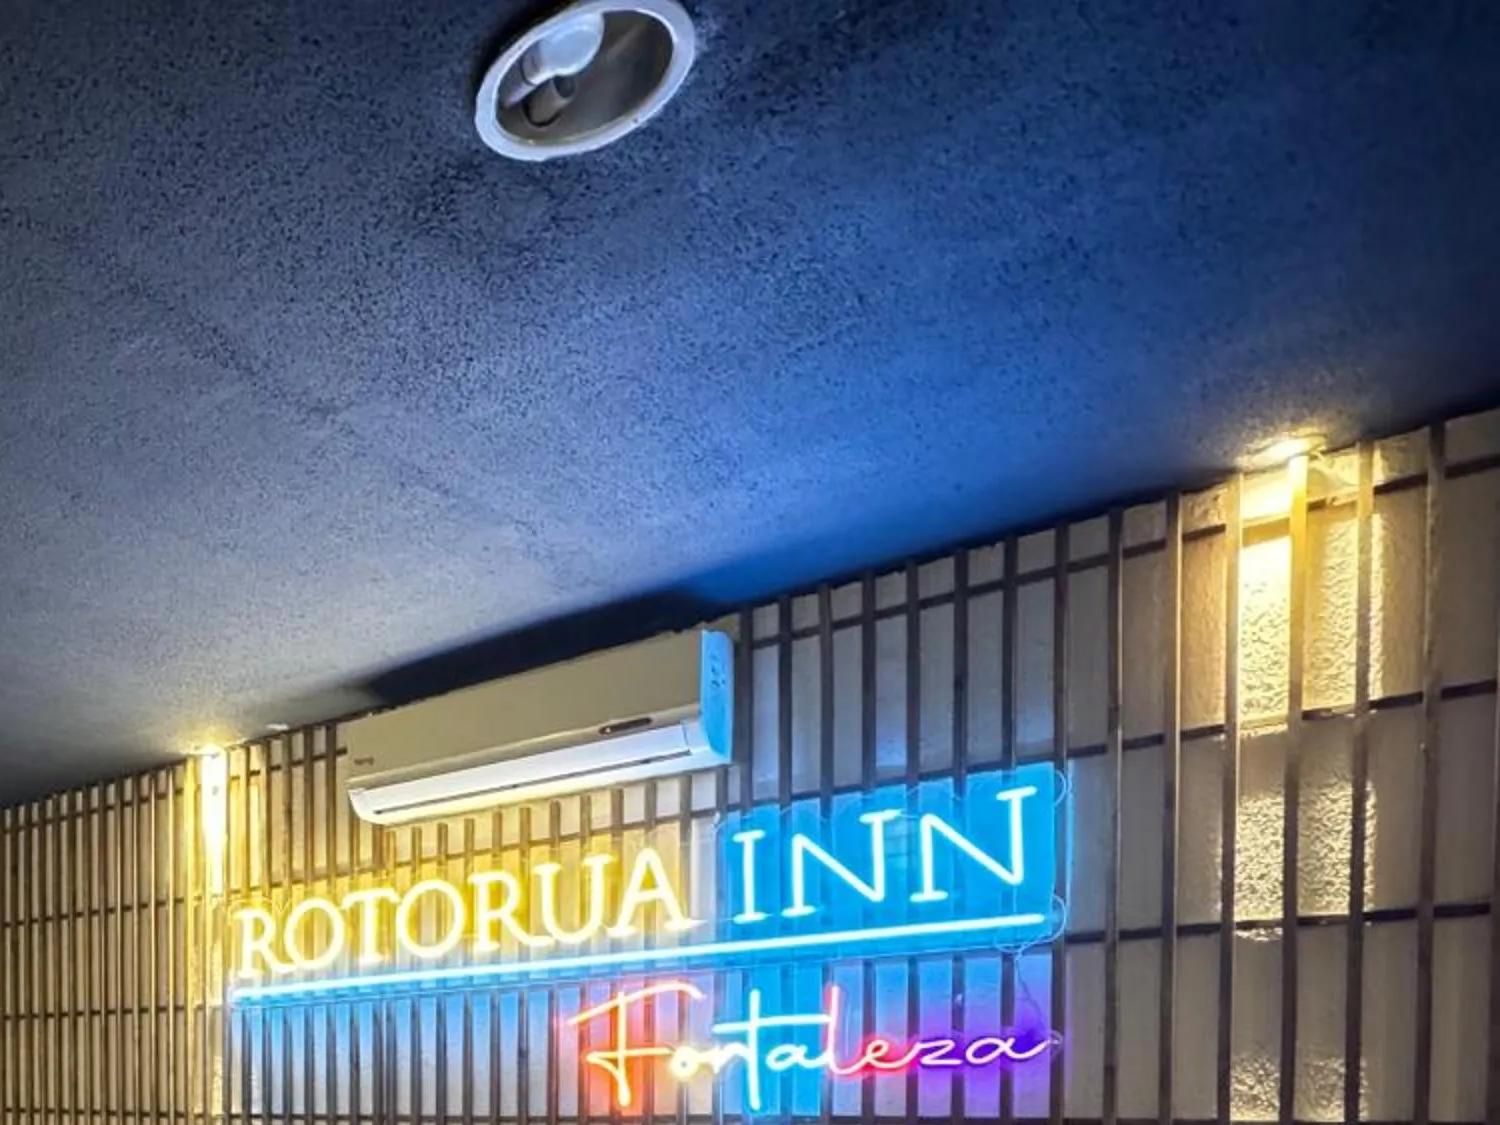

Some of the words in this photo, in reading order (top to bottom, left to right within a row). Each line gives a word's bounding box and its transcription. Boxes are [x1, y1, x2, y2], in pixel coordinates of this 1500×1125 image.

[233, 847, 706, 979] ROTORUA
[732, 785, 1038, 925] INN
[570, 982, 1045, 1110] Fortaleza
